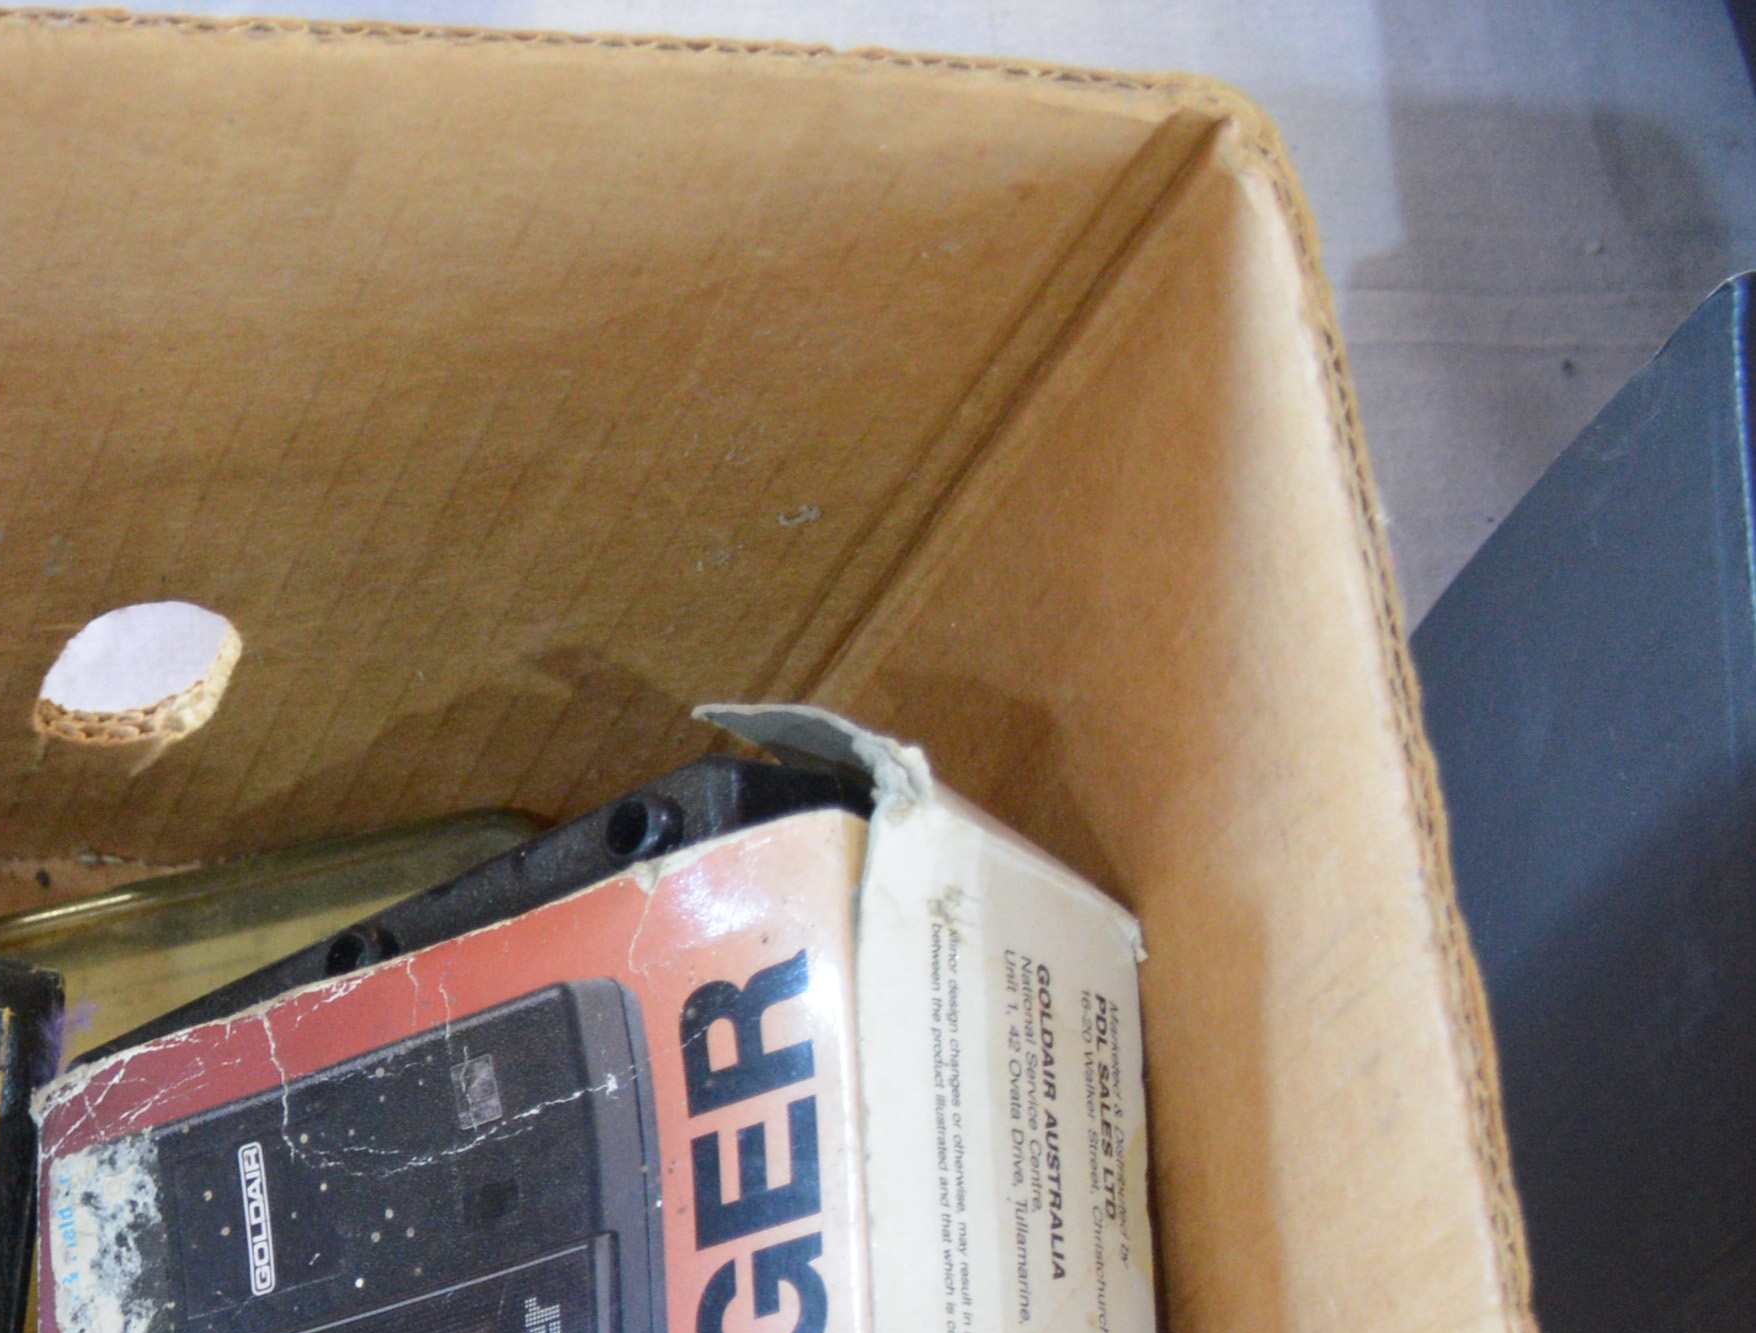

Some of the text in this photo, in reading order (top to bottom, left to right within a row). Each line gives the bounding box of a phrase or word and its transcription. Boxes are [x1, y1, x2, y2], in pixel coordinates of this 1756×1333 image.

[931, 923, 943, 991] between
[947, 928, 958, 976] Minor
[1004, 949, 1017, 994] Unit
[932, 997, 943, 1021] the
[946, 979, 959, 1034] design
[1020, 955, 1035, 1045] National
[929, 1027, 945, 1089] product
[1009, 1025, 1022, 1052] 42
[1109, 1000, 1122, 1100] Marketed
[947, 1039, 962, 1105] changes
[1009, 1058, 1024, 1120] Ovata
[1025, 1052, 1039, 1131] Service
[1084, 1051, 1098, 1120] Walker
[936, 1094, 950, 1170] illustrated
[953, 1112, 963, 1130] or
[1037, 963, 1067, 1280] GOLDAIR AUSTRALIA
[1095, 993, 1116, 1220] PDL SALES LTD
[940, 1173, 951, 1206] and
[1114, 1126, 1128, 1240] Distributed
[243, 1146, 273, 1292] GOLDAIR
[941, 1212, 952, 1244] that
[955, 1221, 968, 1256] may
[943, 1250, 956, 1297] which
[959, 1261, 972, 1306] result
